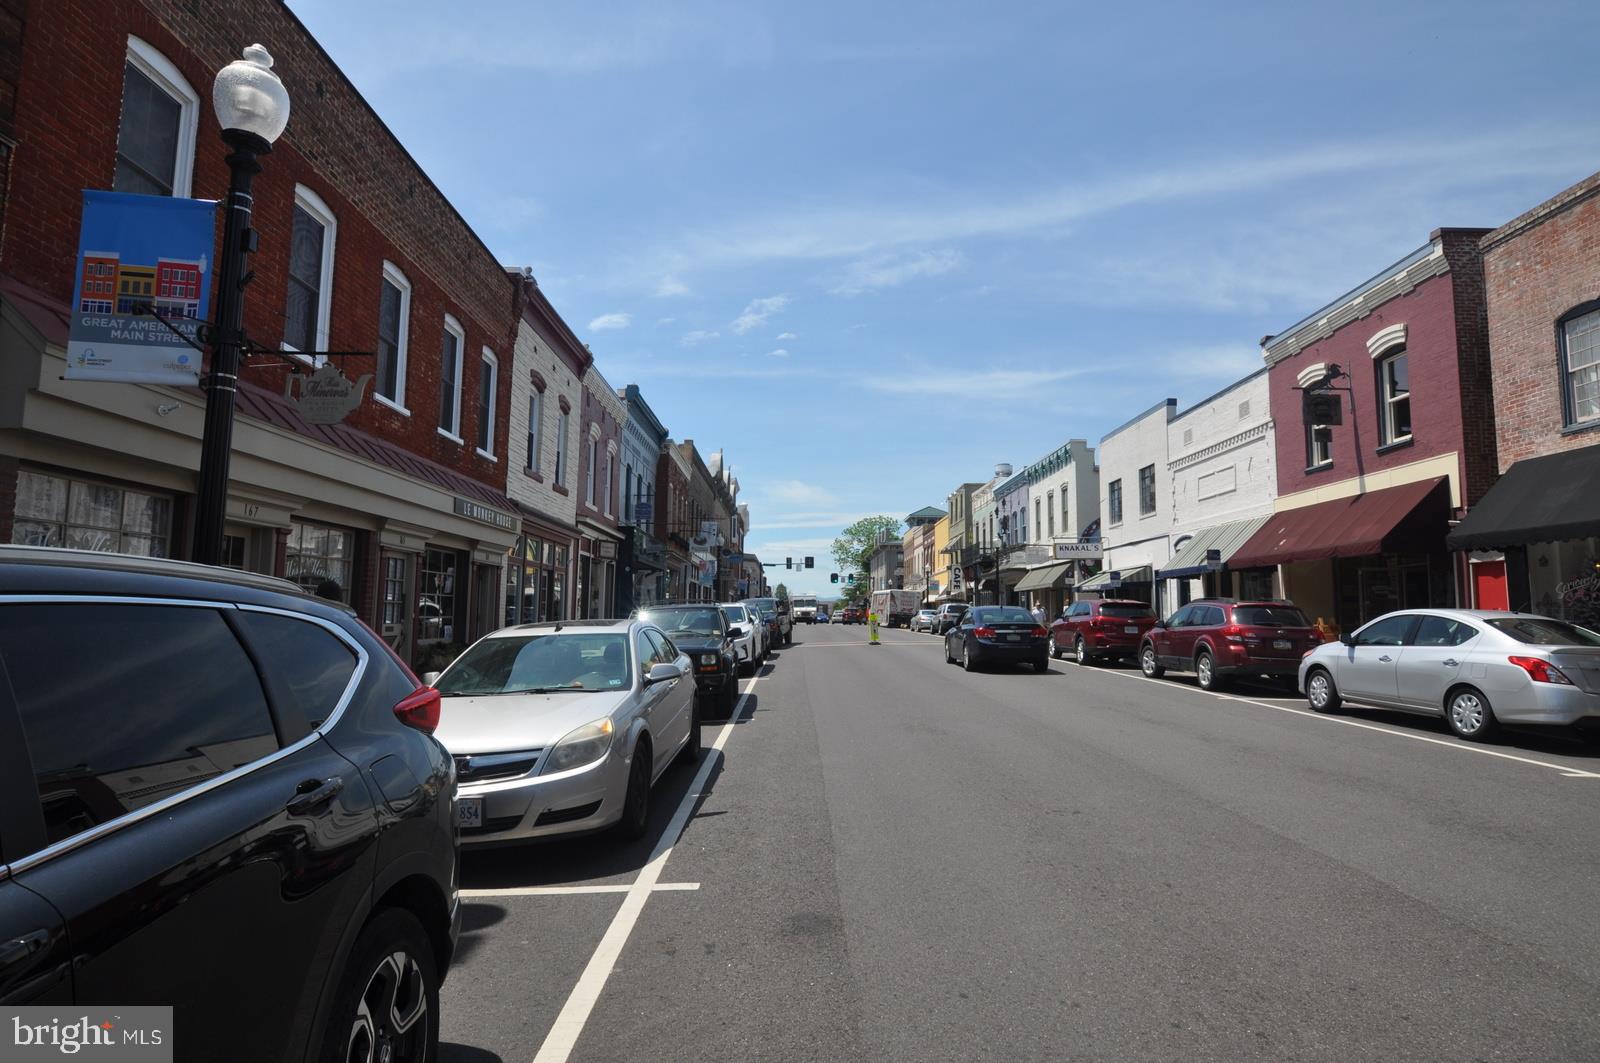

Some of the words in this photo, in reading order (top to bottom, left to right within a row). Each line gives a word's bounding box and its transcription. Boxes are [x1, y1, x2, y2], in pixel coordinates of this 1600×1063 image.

[82, 317, 126, 328] GREAT
[110, 330, 144, 341] MAIN
[148, 332, 196, 343] STREET
[244, 503, 259, 518] 167
[463, 502, 471, 516] LE
[473, 505, 494, 523] MONKEY
[1059, 544, 1100, 552] KNAKAL'S
[953, 567, 961, 590] CAFE
[459, 806, 479, 820] 854
